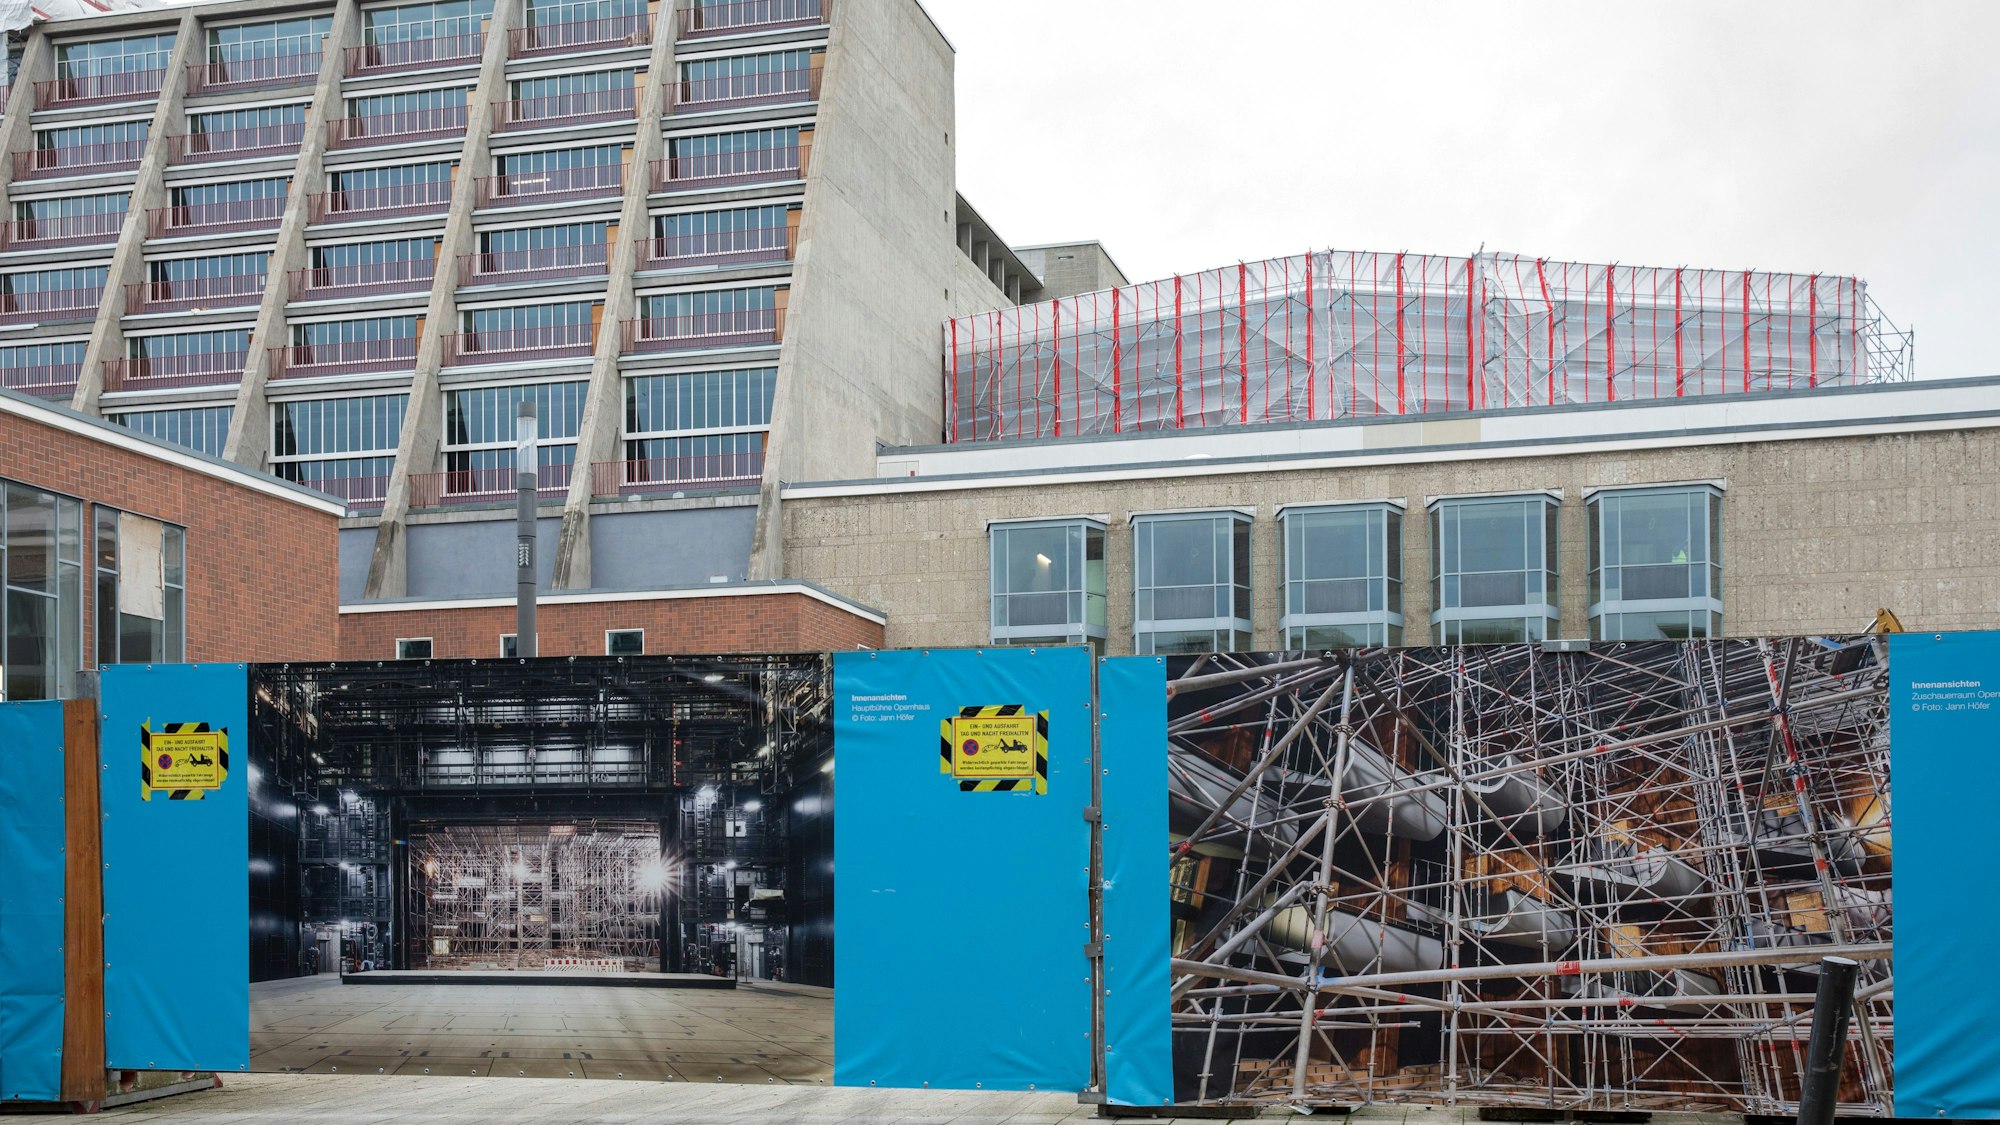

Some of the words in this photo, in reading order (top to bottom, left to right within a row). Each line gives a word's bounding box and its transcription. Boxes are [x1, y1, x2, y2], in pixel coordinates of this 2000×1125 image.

[1912, 680, 1980, 689] Innenansichten
[1912, 692, 1976, 700] Zuschauerraum
[852, 704, 892, 712] Hauptbühne
[893, 703, 930, 712] Opernhaus
